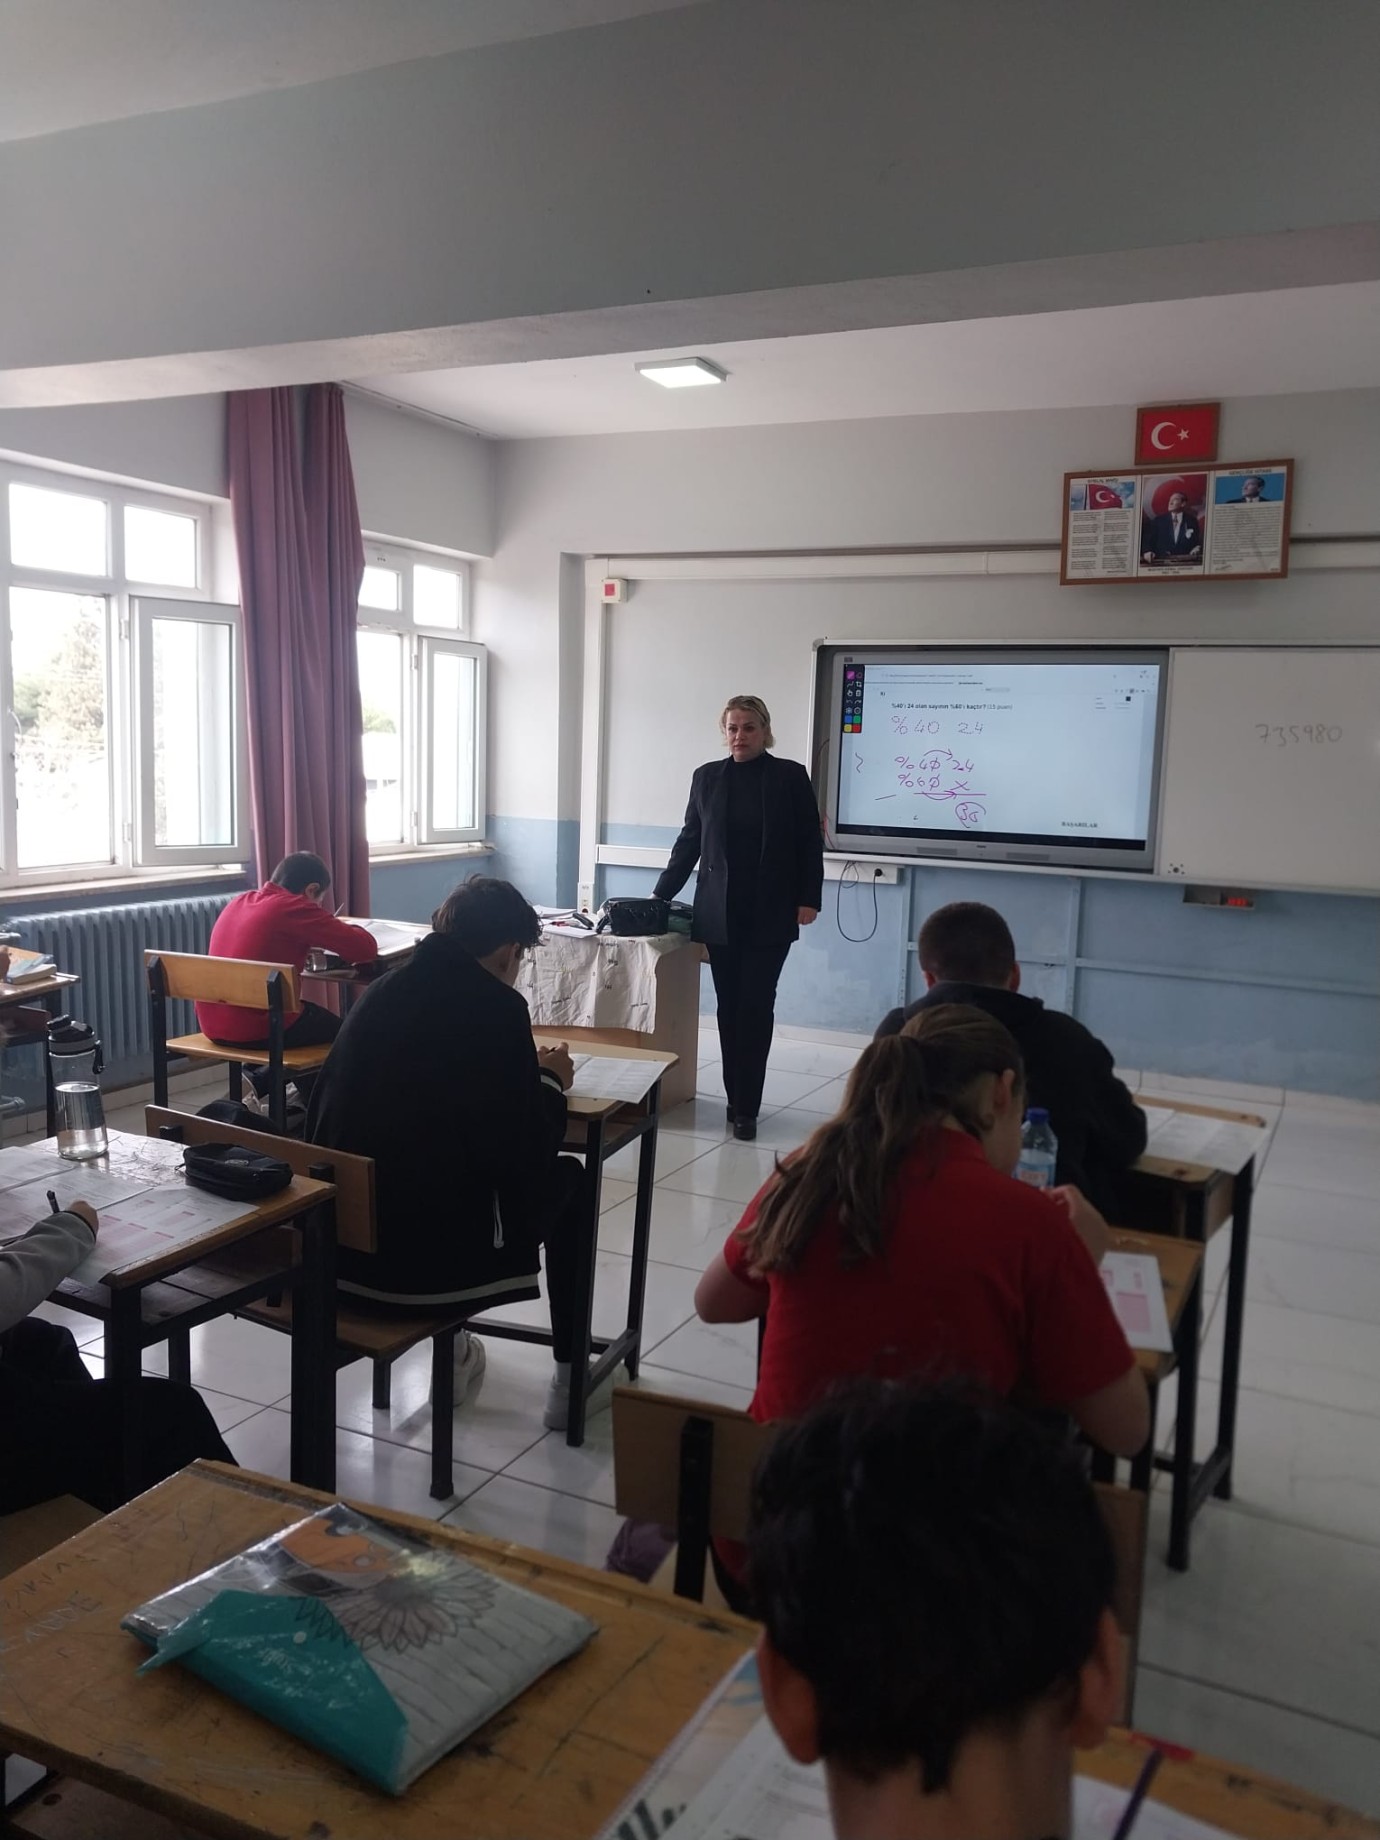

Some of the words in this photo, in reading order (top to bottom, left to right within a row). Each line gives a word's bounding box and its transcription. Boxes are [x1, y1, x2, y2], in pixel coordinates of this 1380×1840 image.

[957, 722, 984, 735] 24
[1255, 723, 1343, 747] 735980
[952, 758, 975, 772] 24
